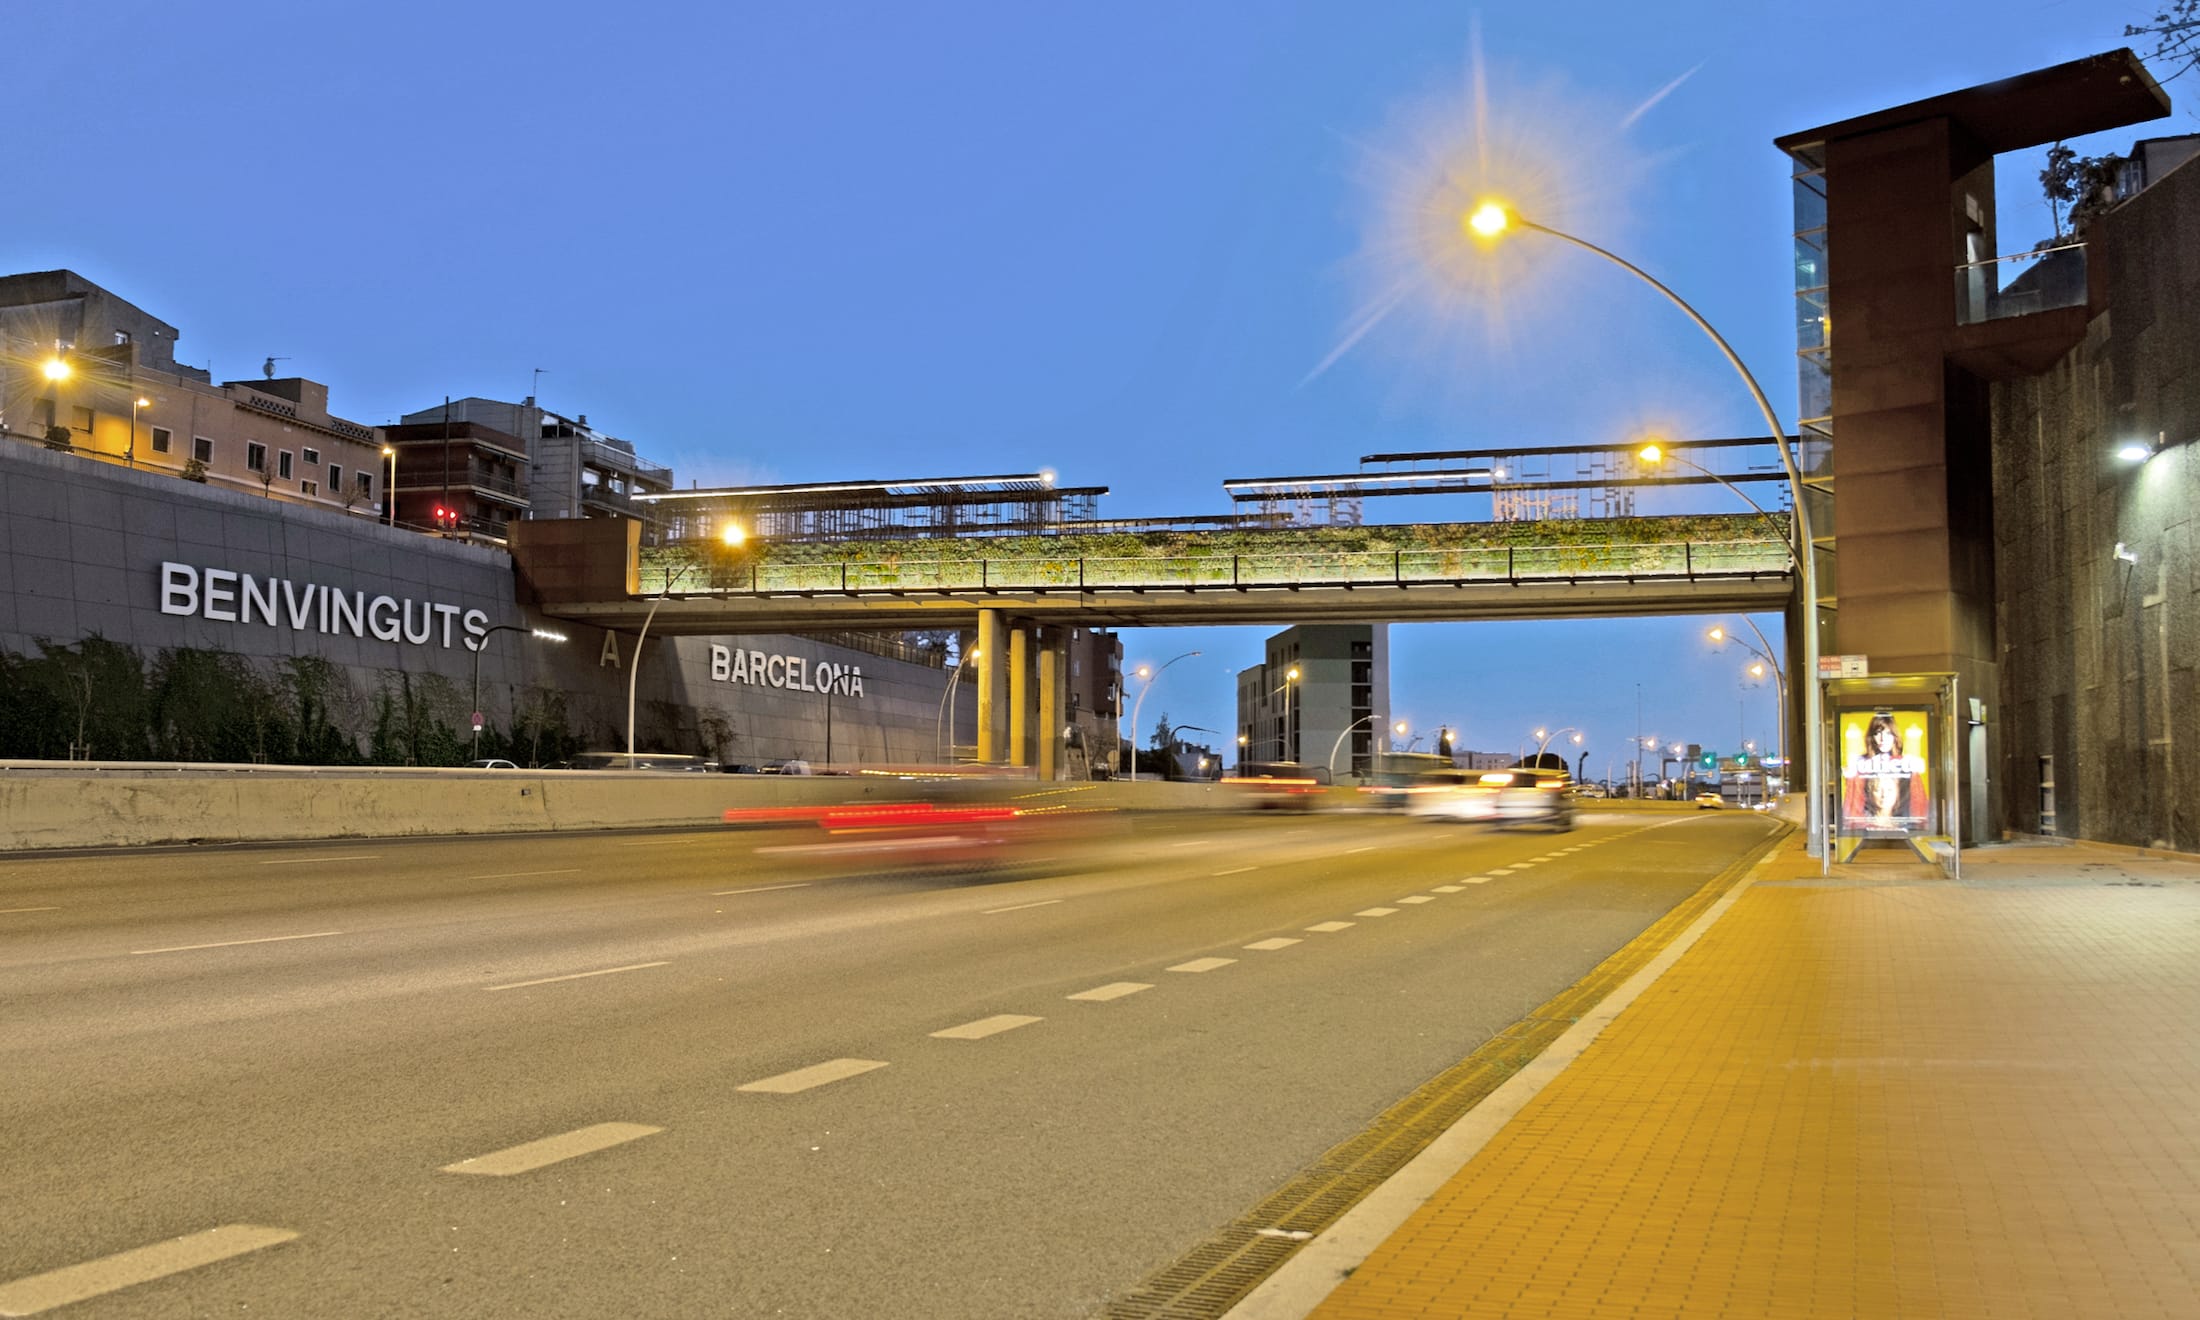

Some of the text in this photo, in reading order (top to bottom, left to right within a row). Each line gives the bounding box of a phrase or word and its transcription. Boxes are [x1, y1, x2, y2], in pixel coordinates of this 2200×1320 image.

[161, 561, 865, 698] BENVINGUTS A BARCELONA
